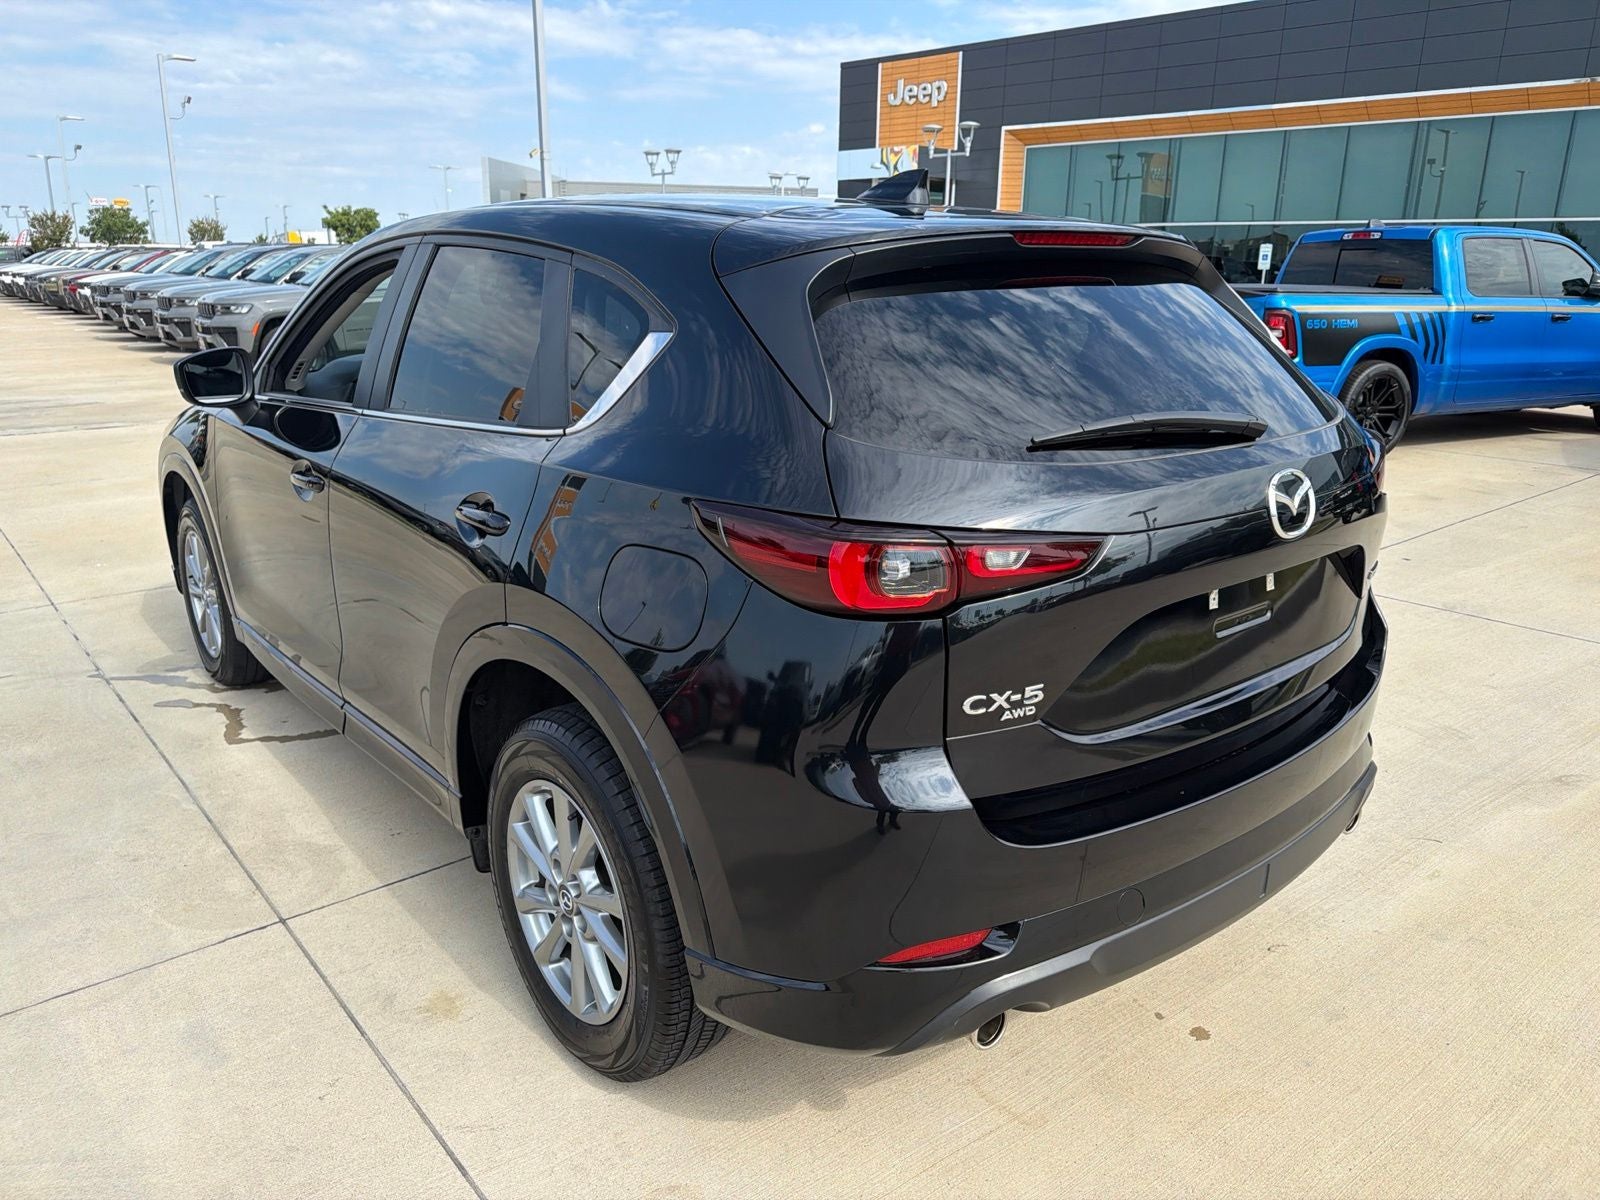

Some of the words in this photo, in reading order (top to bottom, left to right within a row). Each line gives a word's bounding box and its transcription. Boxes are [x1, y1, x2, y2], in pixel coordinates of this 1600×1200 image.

[887, 78, 948, 107] Jeep
[1306, 319, 1328, 329] 650
[1332, 319, 1359, 329] HEMI
[962, 683, 1045, 715] CX-5
[1000, 705, 1037, 721] AWD
